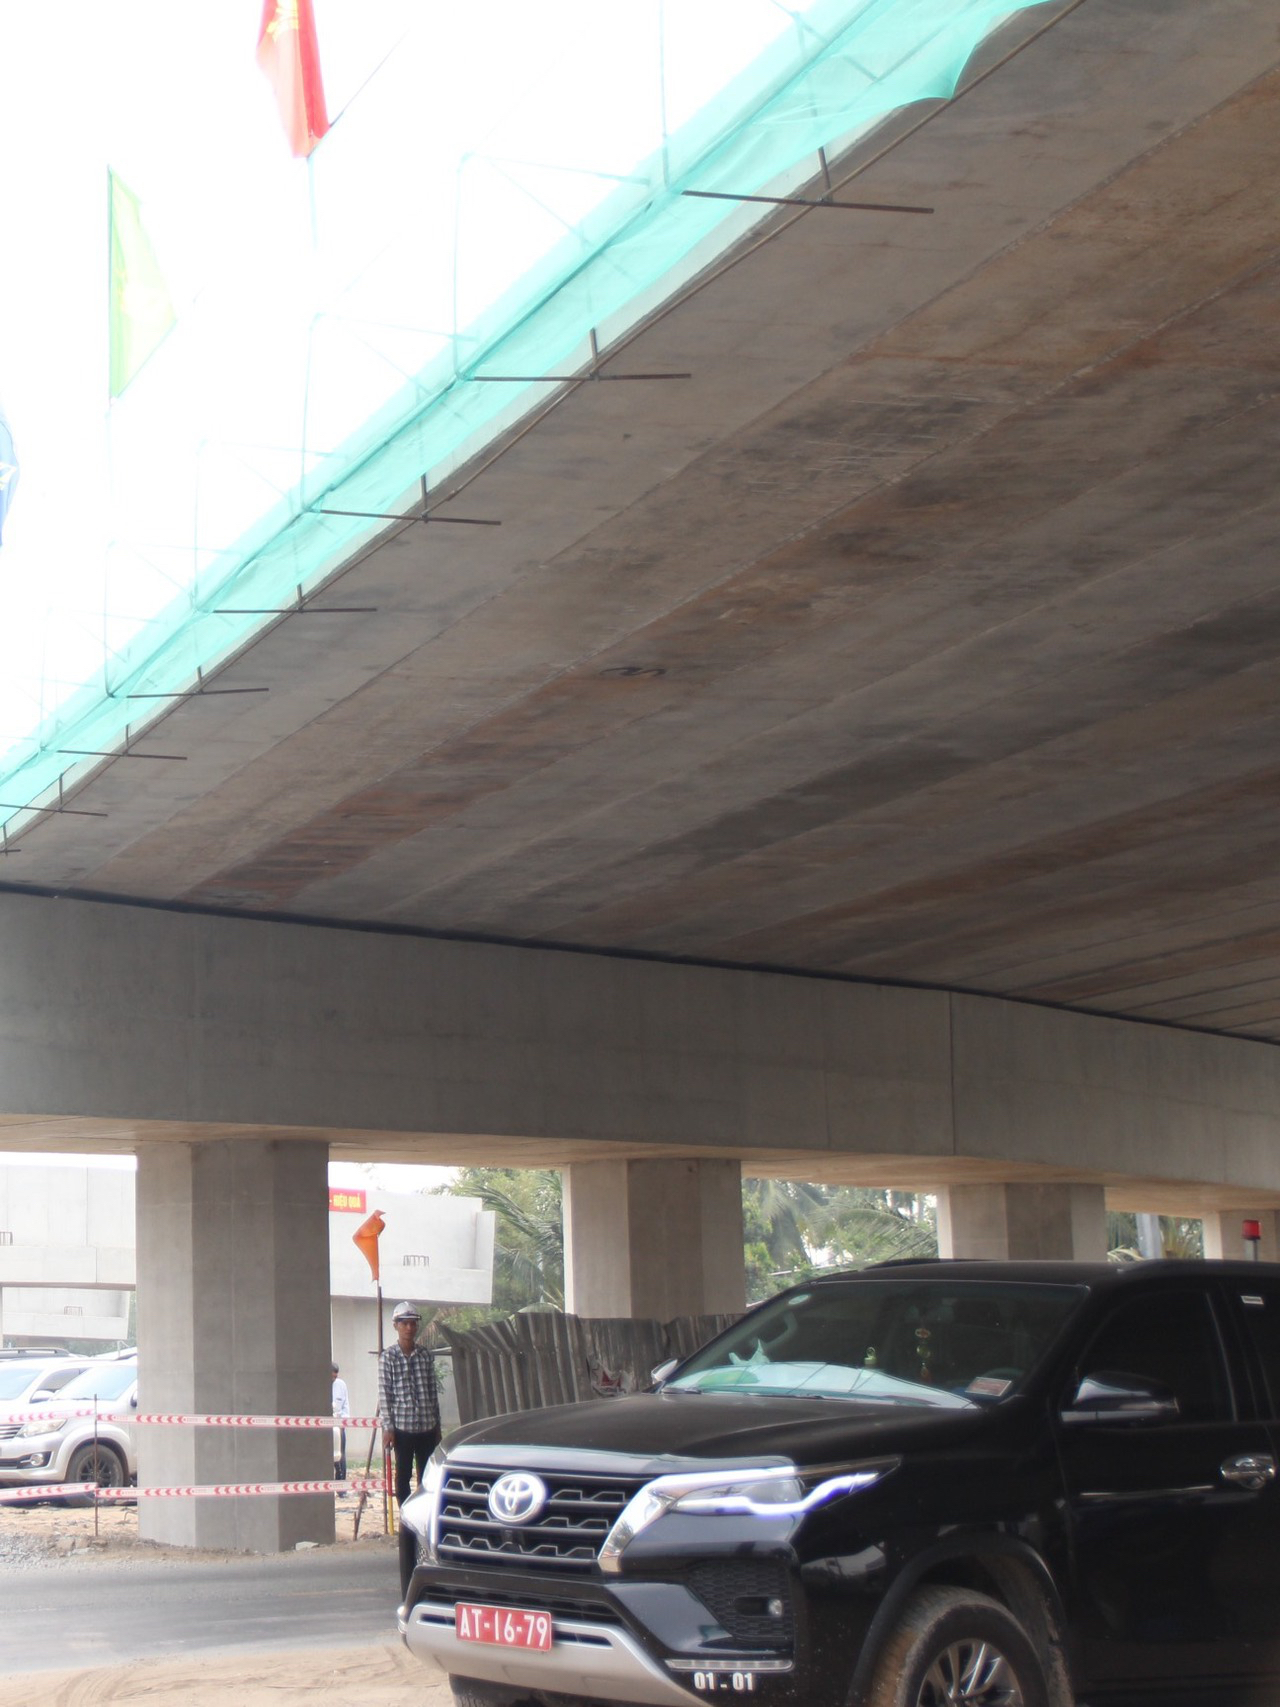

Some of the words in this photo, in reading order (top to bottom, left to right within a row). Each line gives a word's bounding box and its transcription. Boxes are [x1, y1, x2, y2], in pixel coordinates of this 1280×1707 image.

[460, 1607, 548, 1647] AT-16-79
[694, 1671, 715, 1690] 01
[732, 1672, 753, 1691] 01
